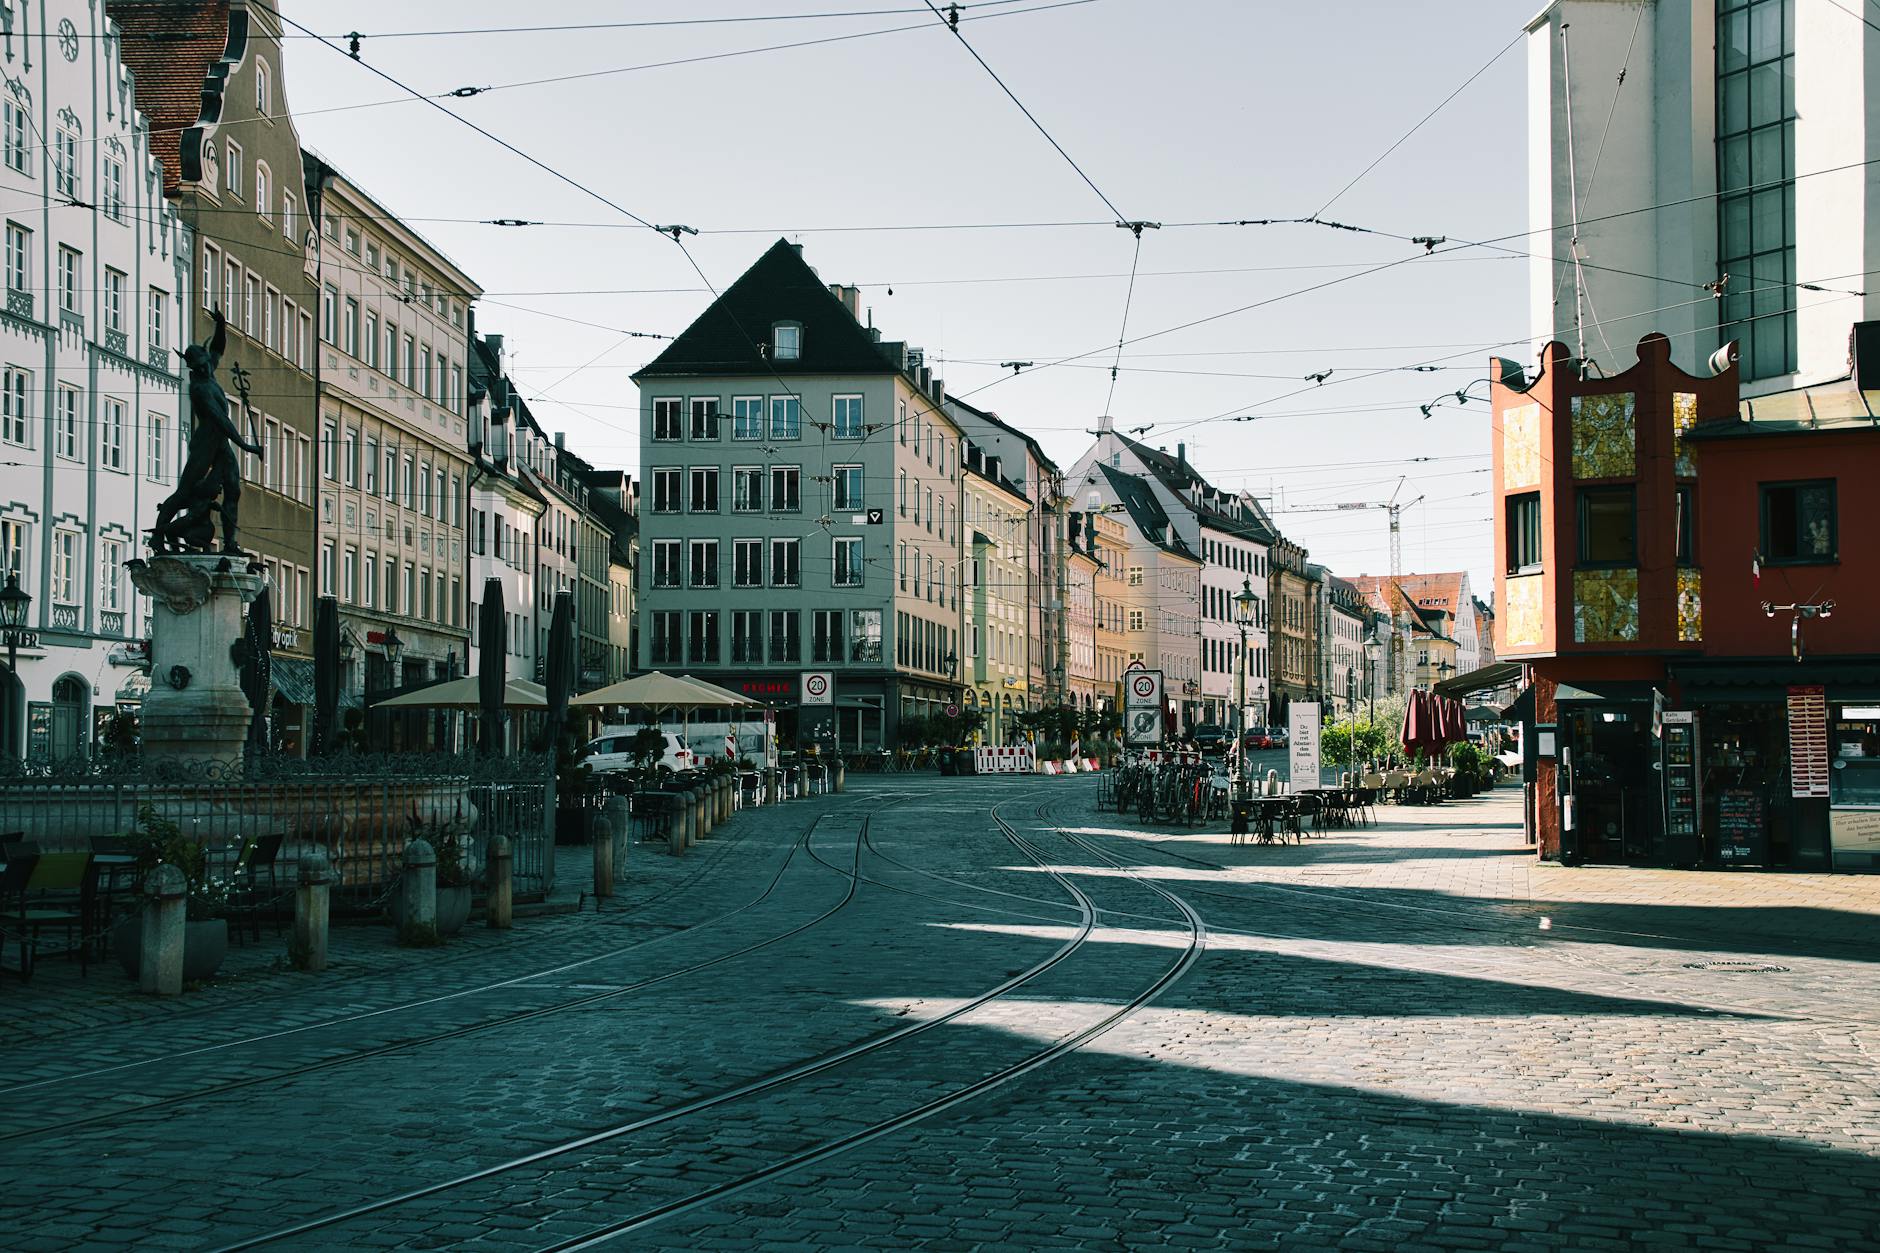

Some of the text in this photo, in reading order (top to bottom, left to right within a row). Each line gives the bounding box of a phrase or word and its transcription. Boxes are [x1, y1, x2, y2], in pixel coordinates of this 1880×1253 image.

[281, 630, 298, 650] optik
[811, 680, 823, 690] 20
[1138, 681, 1151, 692] 20
